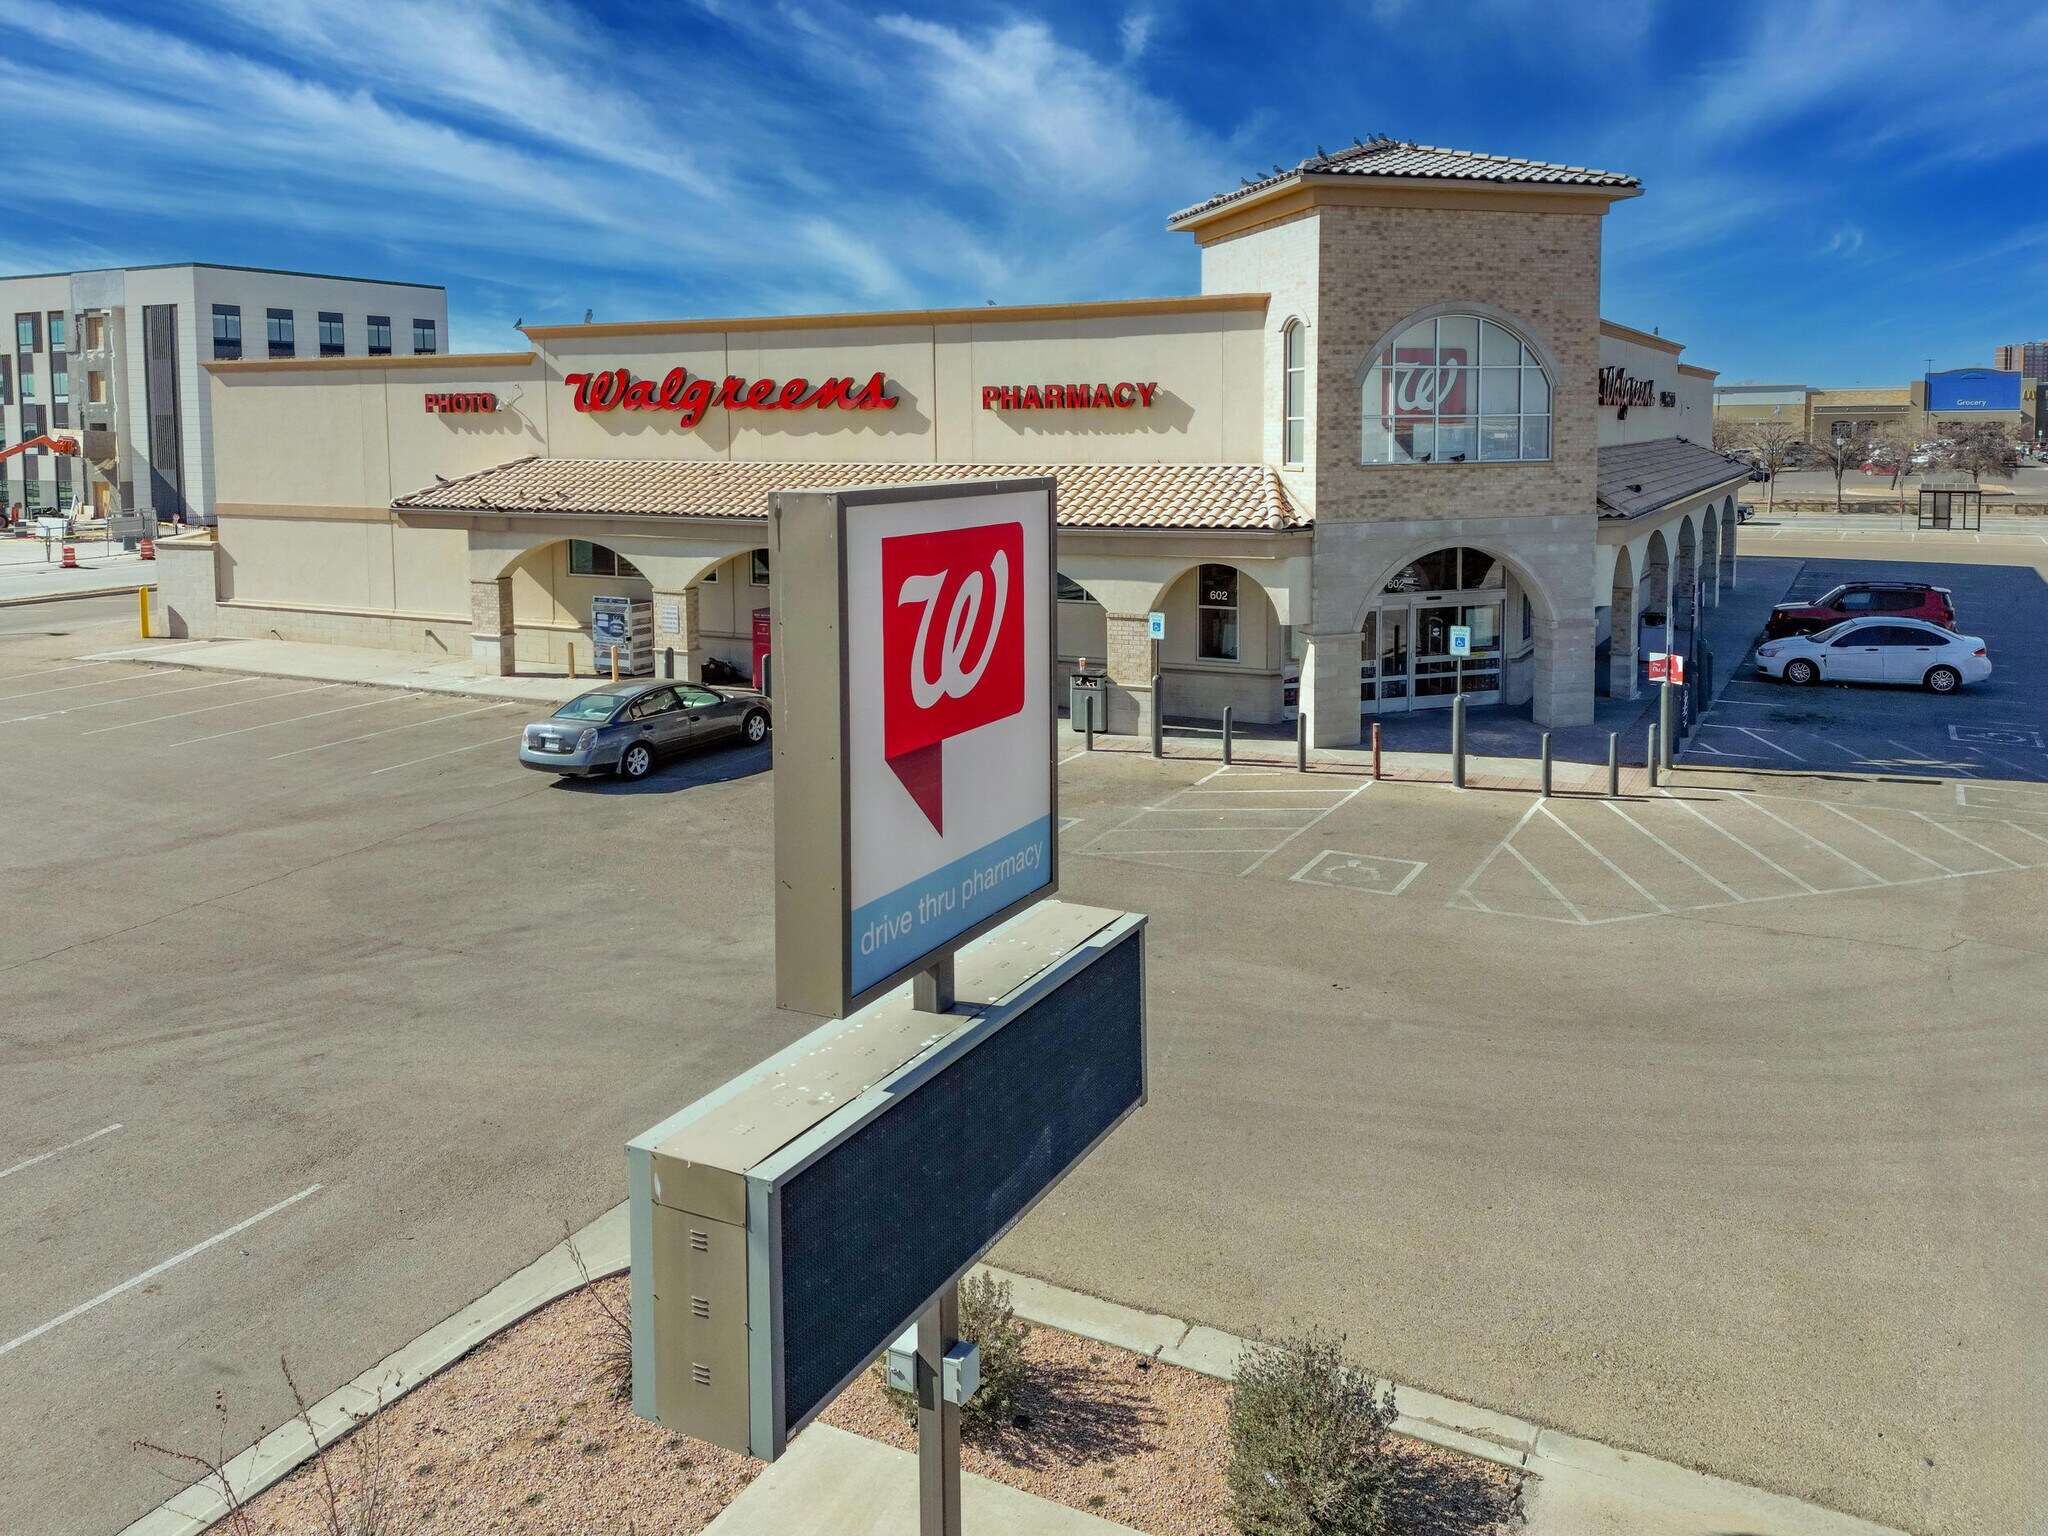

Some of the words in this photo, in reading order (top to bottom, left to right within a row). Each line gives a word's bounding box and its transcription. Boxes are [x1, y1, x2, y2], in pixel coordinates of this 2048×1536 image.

[565, 366, 898, 428] Walgreens
[982, 382, 1158, 410] PHARMACY
[1395, 357, 1458, 411] W
[425, 392, 497, 414] PHOTO
[1956, 399, 1987, 408] Grocery
[1210, 590, 1228, 602] 602
[1387, 579, 1405, 589] 602
[897, 548, 1009, 710] W
[860, 909, 914, 956] drive
[918, 885, 957, 926] thru
[961, 839, 1044, 903] pharmacy
